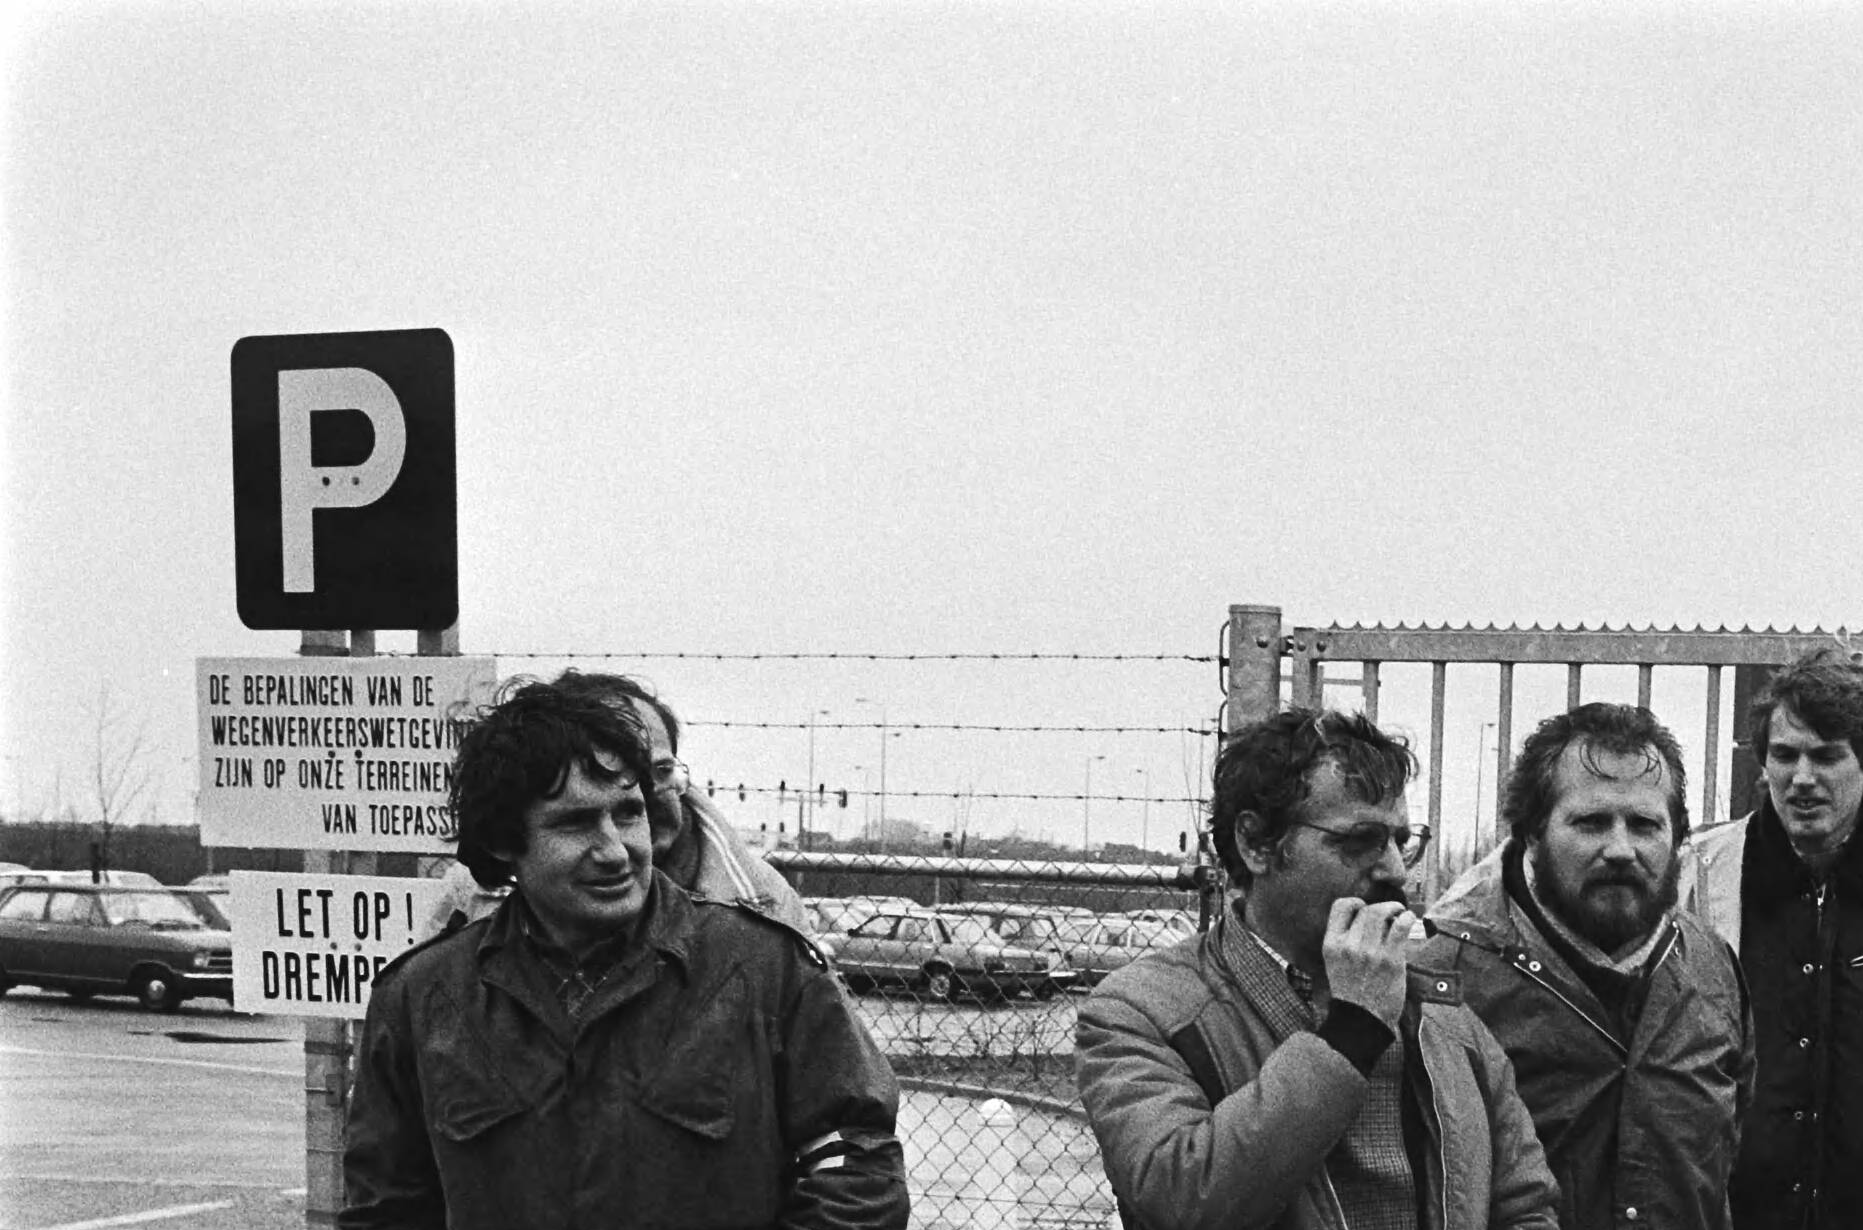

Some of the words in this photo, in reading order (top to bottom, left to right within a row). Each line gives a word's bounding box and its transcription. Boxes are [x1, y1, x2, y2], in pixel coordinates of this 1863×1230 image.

[277, 366, 406, 593] P
[209, 674, 231, 706] DE
[243, 674, 354, 706] BEPALINGEN
[366, 675, 402, 707] VAN
[412, 675, 435, 707] DE
[214, 757, 253, 788] ZIJN
[263, 758, 286, 789] OP
[298, 759, 345, 790] ONZE
[322, 804, 357, 834] VAN
[276, 888, 334, 939] LET
[353, 891, 391, 942] OP
[405, 892, 415, 945] !
